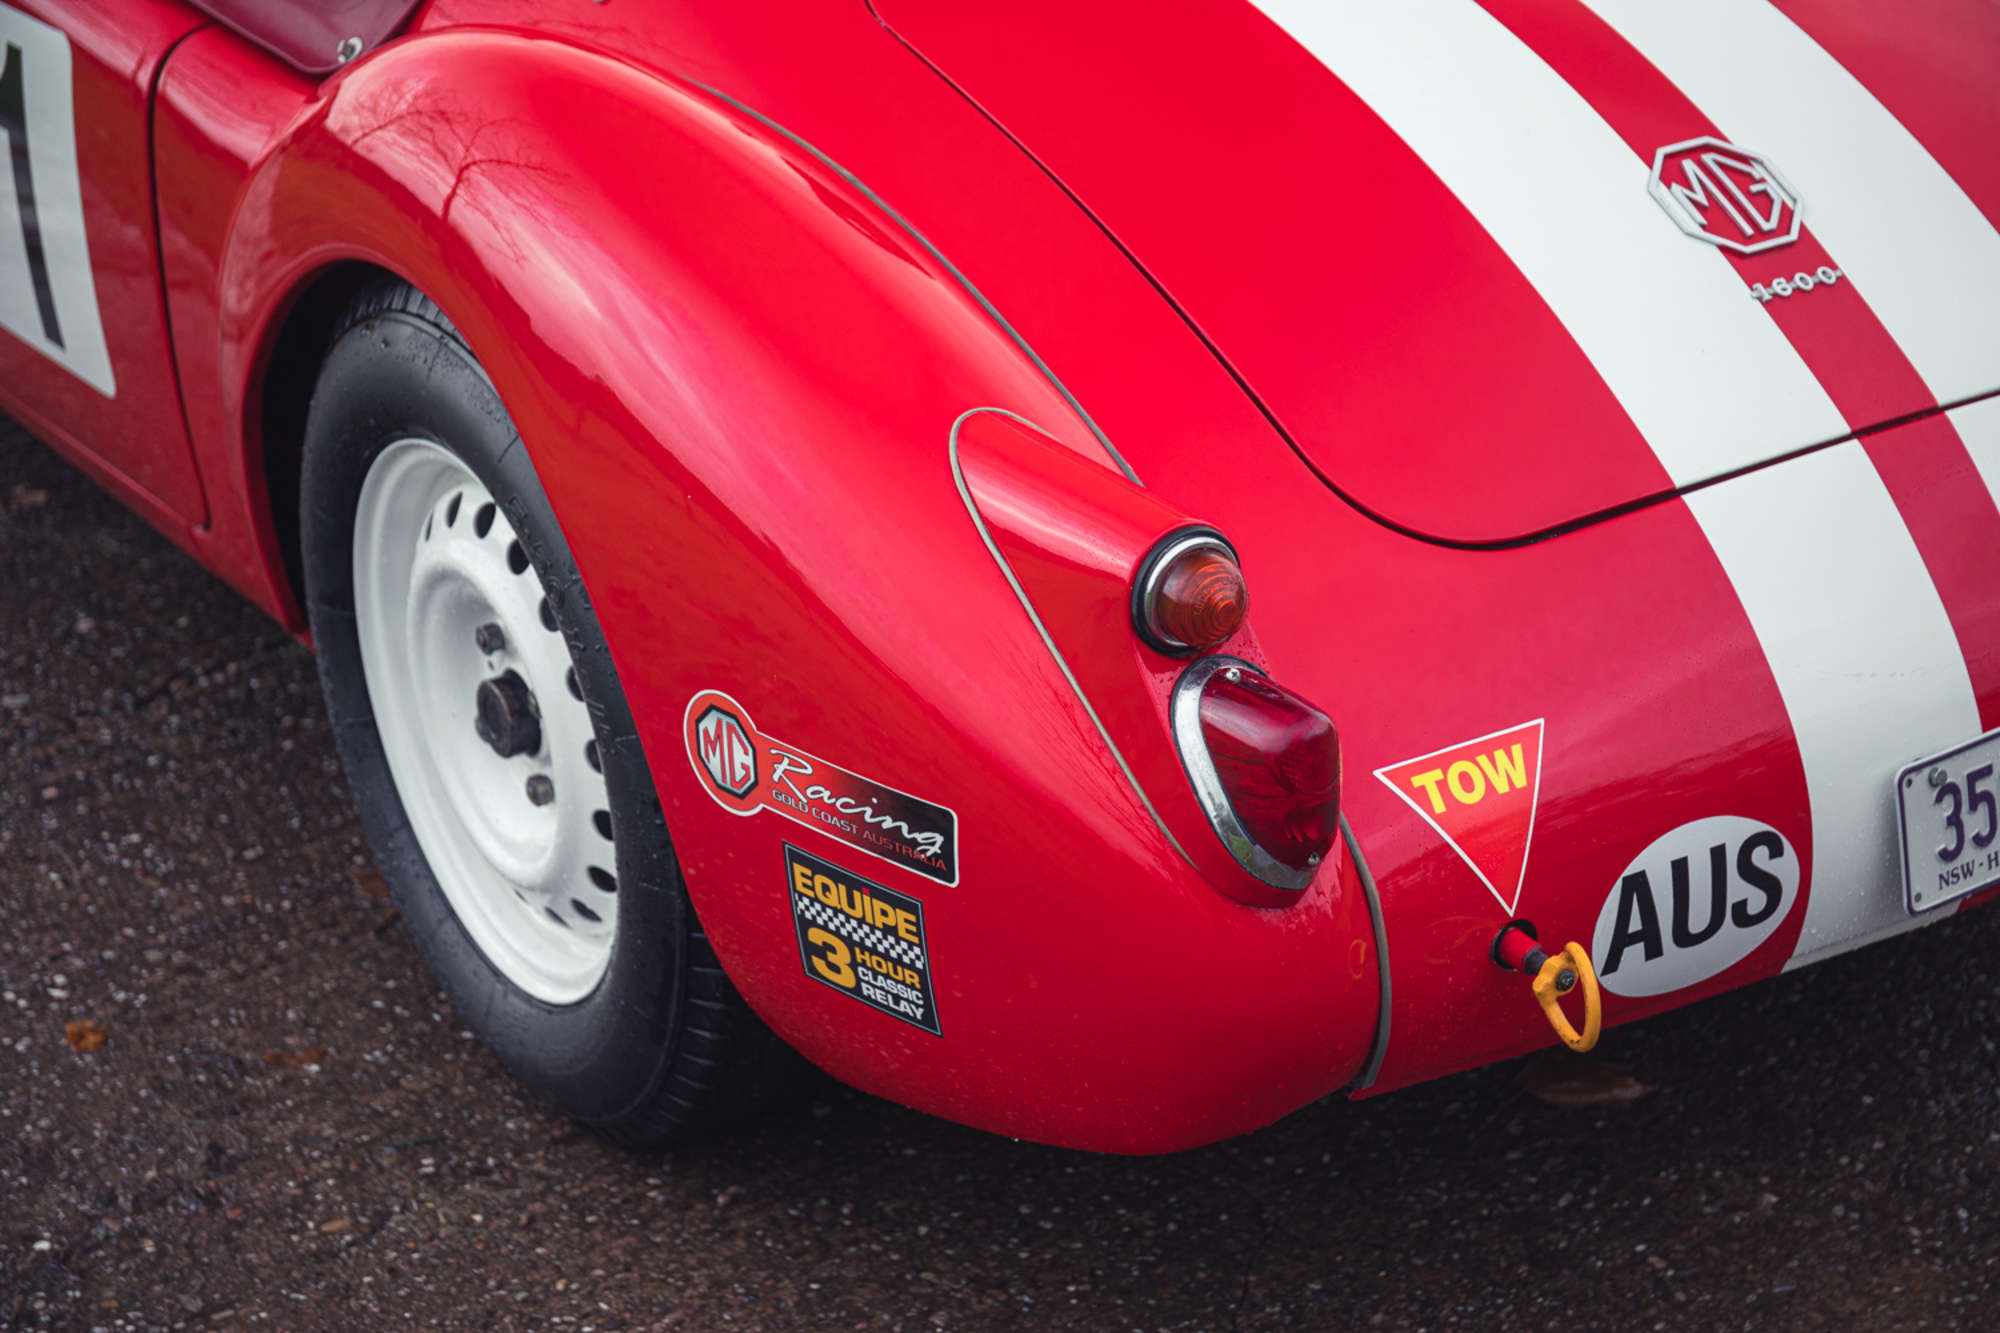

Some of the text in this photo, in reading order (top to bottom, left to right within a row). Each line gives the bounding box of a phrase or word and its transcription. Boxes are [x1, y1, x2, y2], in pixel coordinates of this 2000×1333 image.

[1669, 152, 1783, 237] MG
[1751, 265, 1843, 303] 1600
[702, 716, 752, 791] MG
[1411, 743, 1528, 815] TOW
[770, 748, 945, 859] Racing
[771, 788, 947, 871] GOLD COAST AUSTRALIA
[1600, 830, 1785, 978] AUS
[1938, 860, 1975, 890] NSW
[807, 927, 920, 989] 3 HOUR
[857, 966, 924, 1005] CLASSIC
[861, 983, 924, 1020] RELAY
